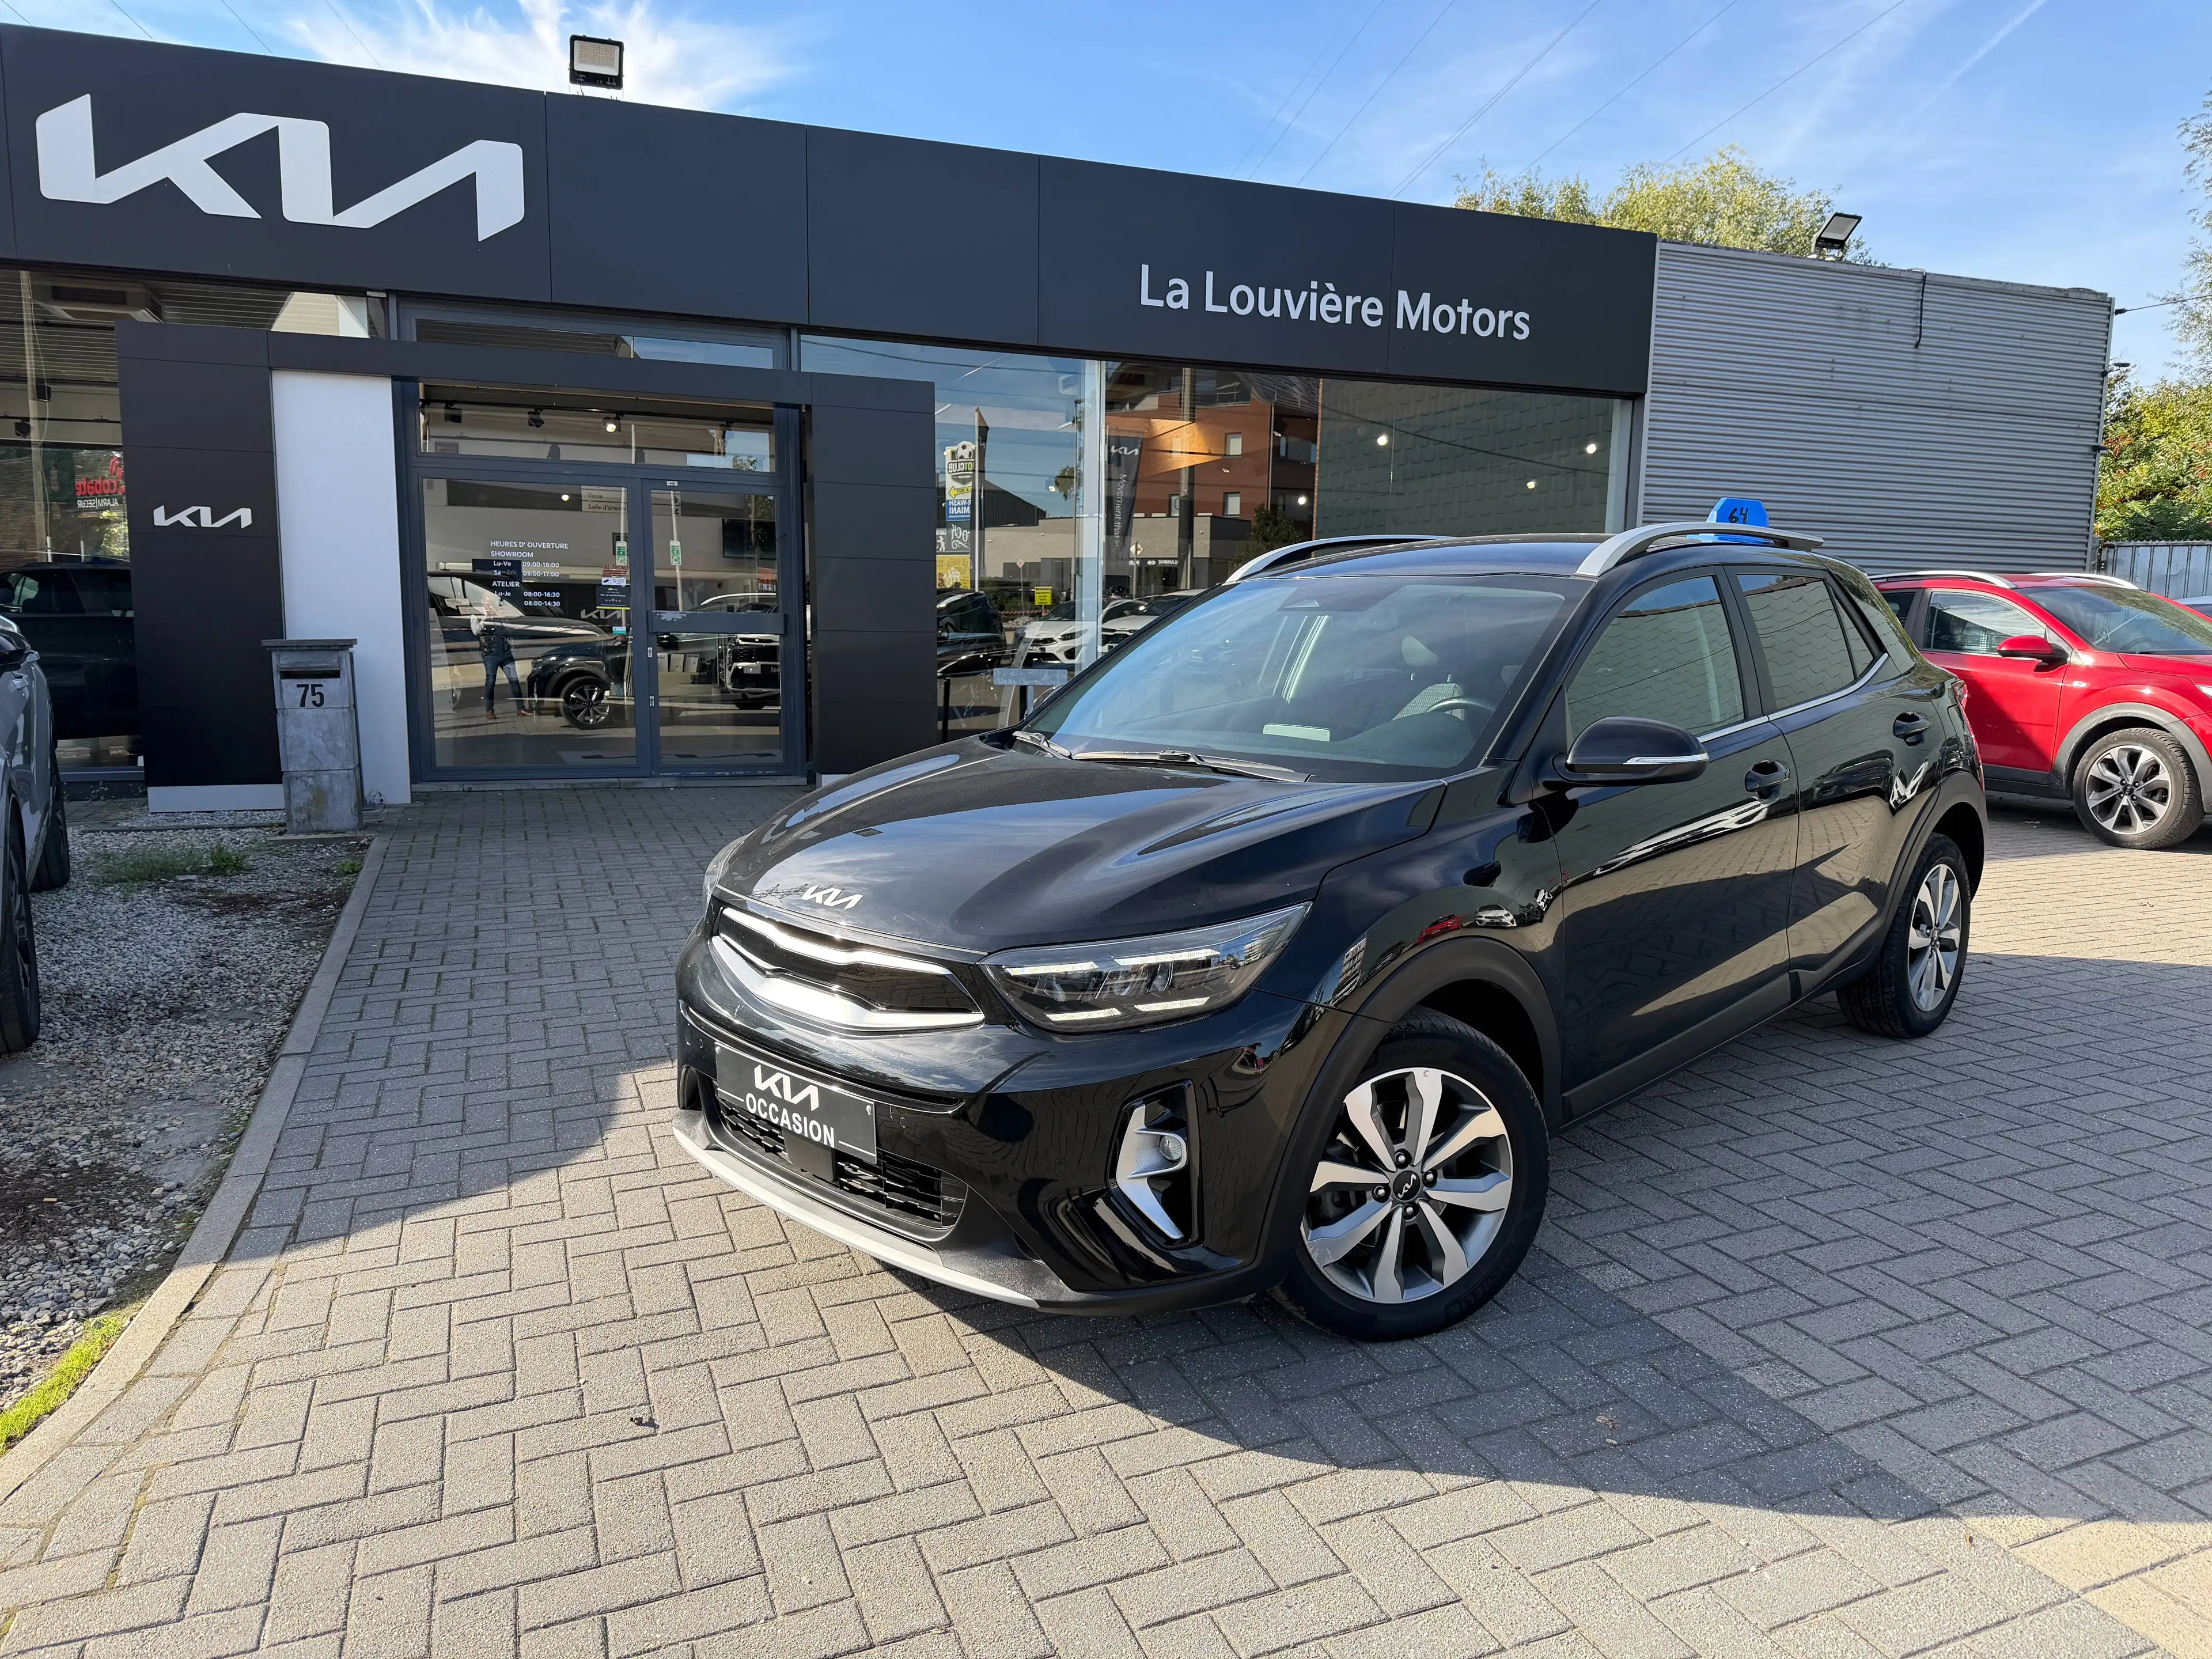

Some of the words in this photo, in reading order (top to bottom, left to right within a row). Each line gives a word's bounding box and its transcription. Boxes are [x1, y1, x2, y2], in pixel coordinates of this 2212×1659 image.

[36, 94, 524, 241] KIA
[1141, 264, 1189, 310] La
[1205, 271, 1383, 328] Louvière
[1396, 290, 1531, 340] Motors
[154, 505, 252, 528] KIA
[1113, 474, 1127, 518] Movement
[1728, 507, 1749, 524] 64
[297, 684, 324, 707] 75
[801, 885, 863, 910] KIA
[754, 1064, 819, 1111] KIA
[745, 1093, 835, 1149] OCCASION
